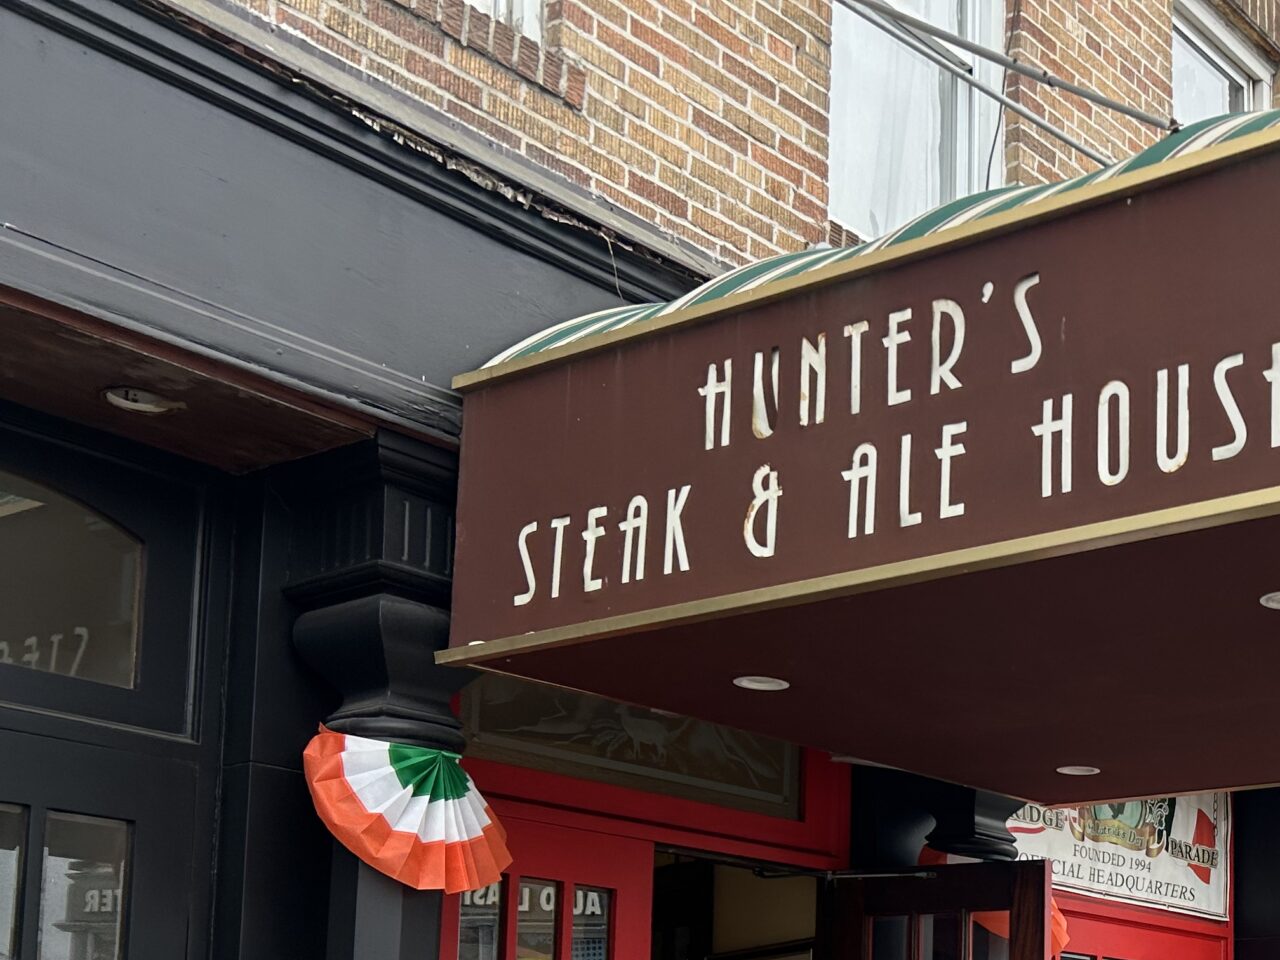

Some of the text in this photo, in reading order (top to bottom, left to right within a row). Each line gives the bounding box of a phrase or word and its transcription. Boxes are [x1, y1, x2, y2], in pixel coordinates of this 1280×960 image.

[697, 273, 1043, 451] HUNTER'S
[513, 484, 692, 607] STEAK
[744, 464, 783, 559] &
[841, 420, 968, 539] ALE
[1019, 852, 1196, 902] OCIAL HEADQUARTERS
[1073, 843, 1152, 873] FOUNDED 1994
[1169, 838, 1219, 867] PARADE
